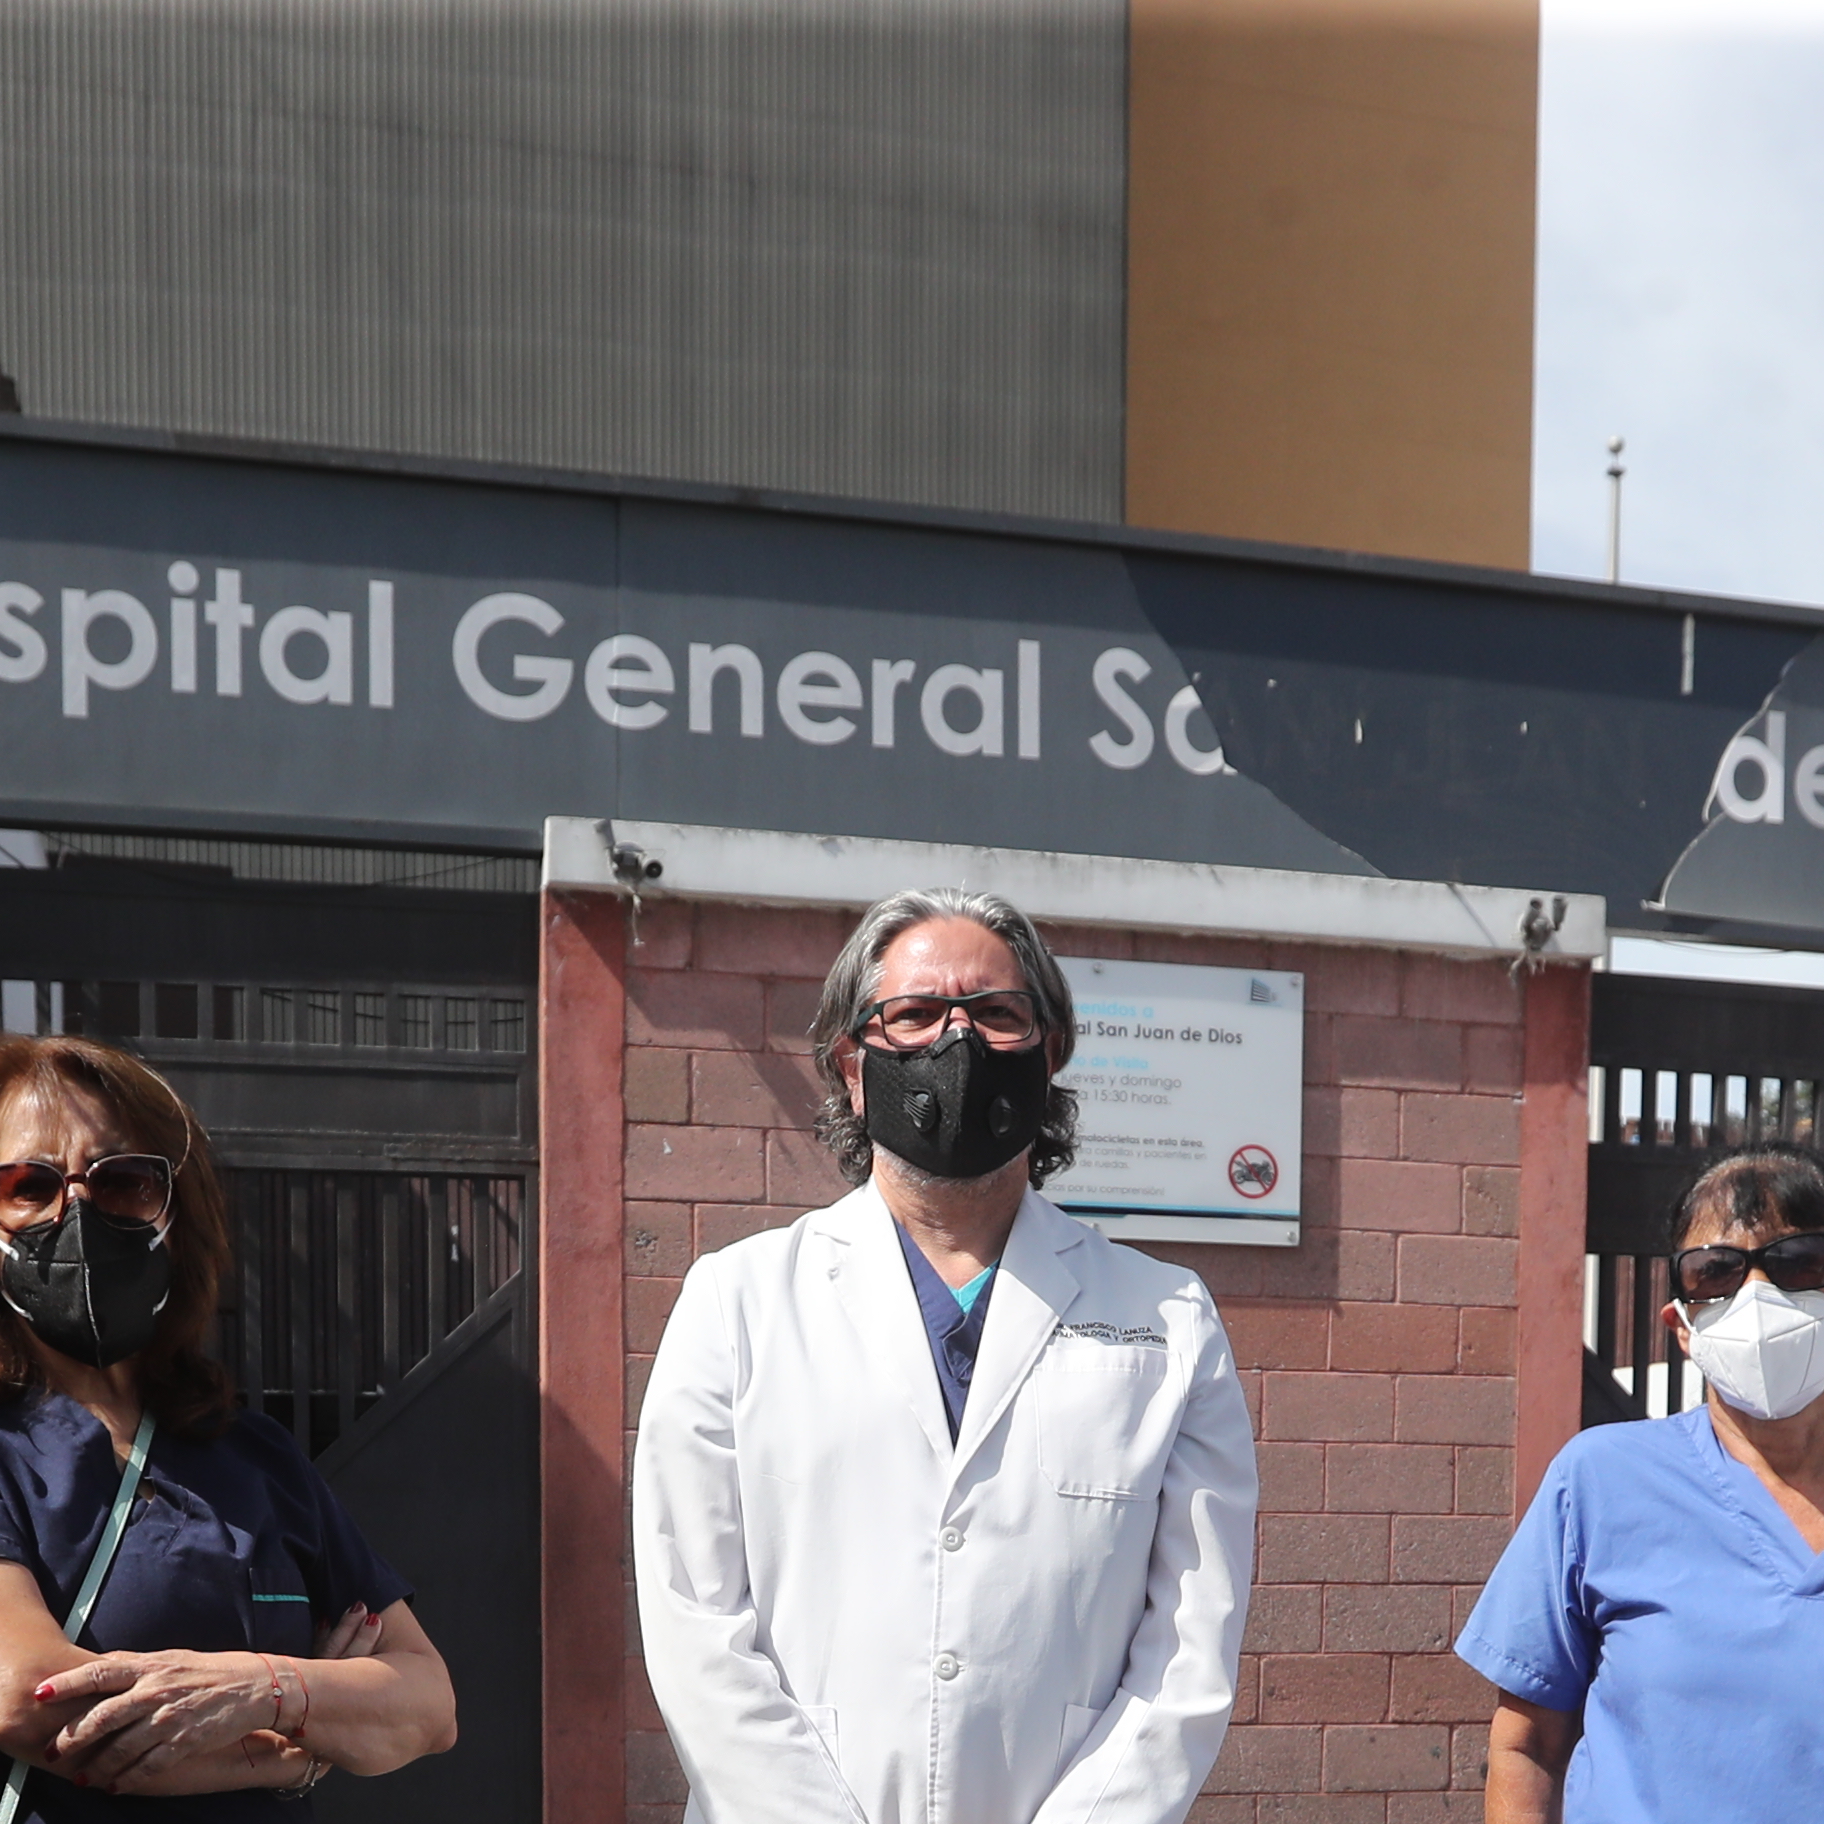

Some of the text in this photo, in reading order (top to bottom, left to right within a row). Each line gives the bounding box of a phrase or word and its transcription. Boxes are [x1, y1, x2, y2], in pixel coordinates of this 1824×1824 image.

[452, 591, 1043, 761] General
[1089, 645, 1239, 776] Sa
[1073, 1001, 1137, 1017] enidos
[1075, 1020, 1244, 1045] al San Juan de Dios
[1120, 1073, 1183, 1091] domingo
